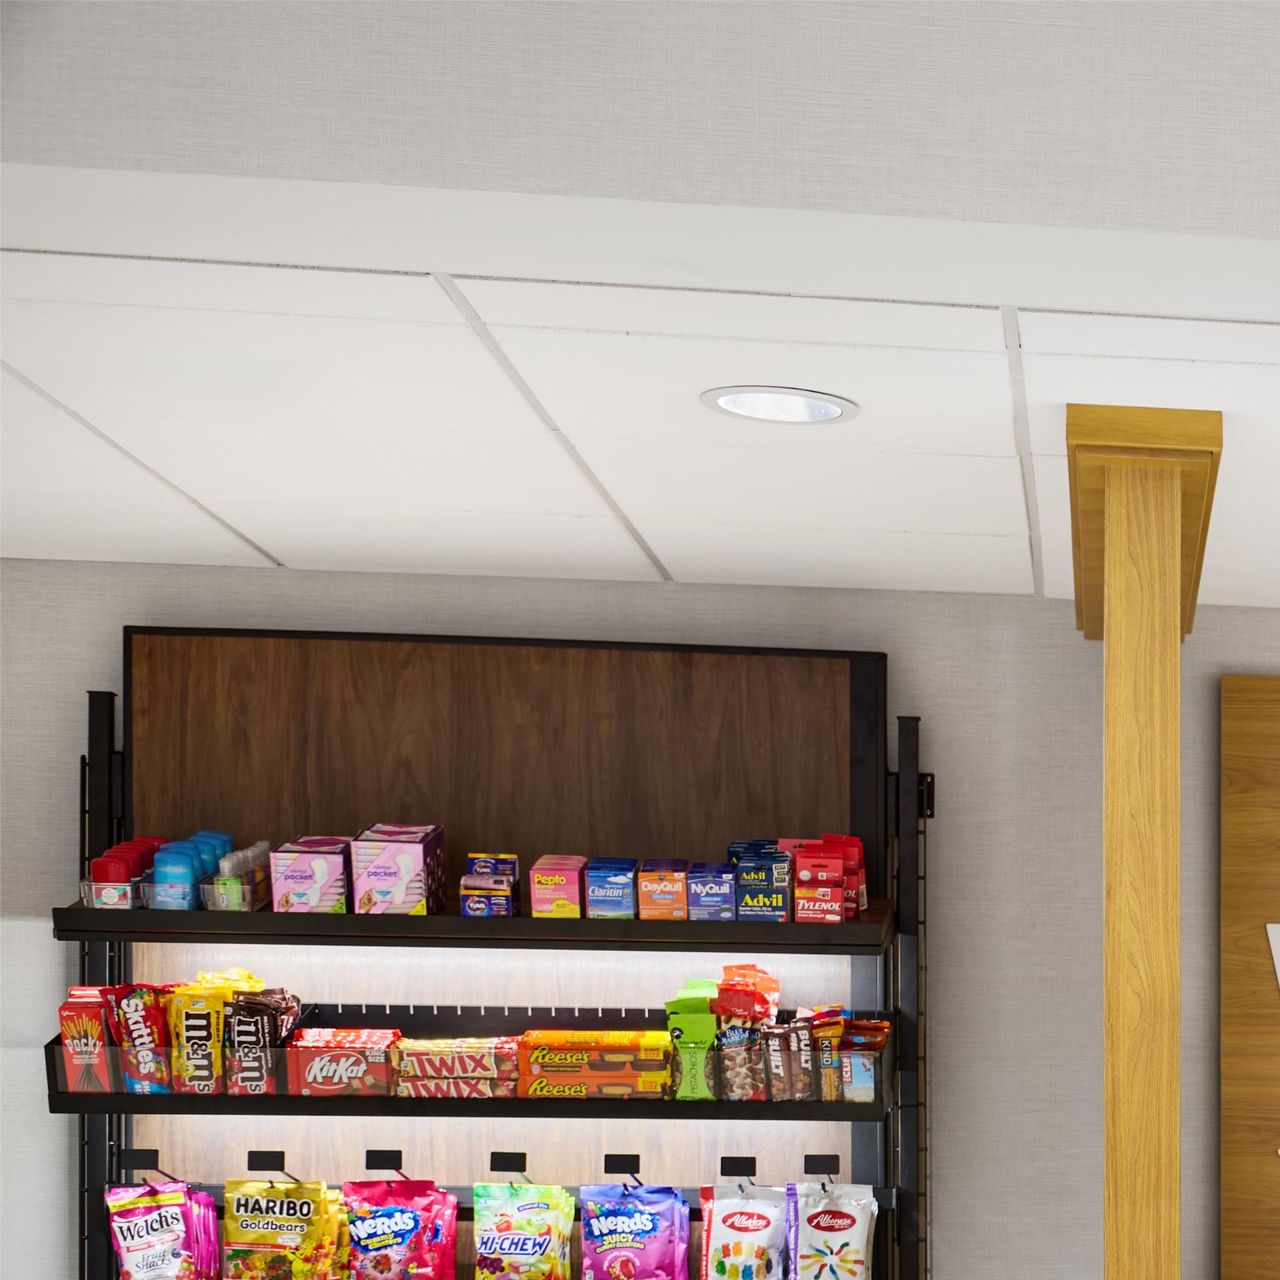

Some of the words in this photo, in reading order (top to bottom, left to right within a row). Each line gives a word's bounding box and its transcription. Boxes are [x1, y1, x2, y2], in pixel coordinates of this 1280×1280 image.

[284, 873, 313, 881] pocket
[367, 870, 397, 879] pocket
[534, 874, 567, 886] Pepto
[741, 872, 766, 880] Advil
[588, 886, 623, 897] Claritin
[641, 881, 683, 894] DayQuil
[691, 882, 730, 896] NyQuil
[741, 893, 783, 907] Advil
[797, 900, 842, 911] TYLENOL
[120, 998, 155, 1074] Skittles
[64, 1036, 103, 1054] POCKY
[797, 1030, 812, 1071] BUILT
[365, 1049, 386, 1057] KING
[822, 1040, 832, 1065] KIND
[235, 1197, 312, 1218] HARIBO
[117, 1210, 180, 1242] Welch's
[240, 1219, 308, 1233] Goldbears
[478, 1235, 551, 1256] HI-CHEW
